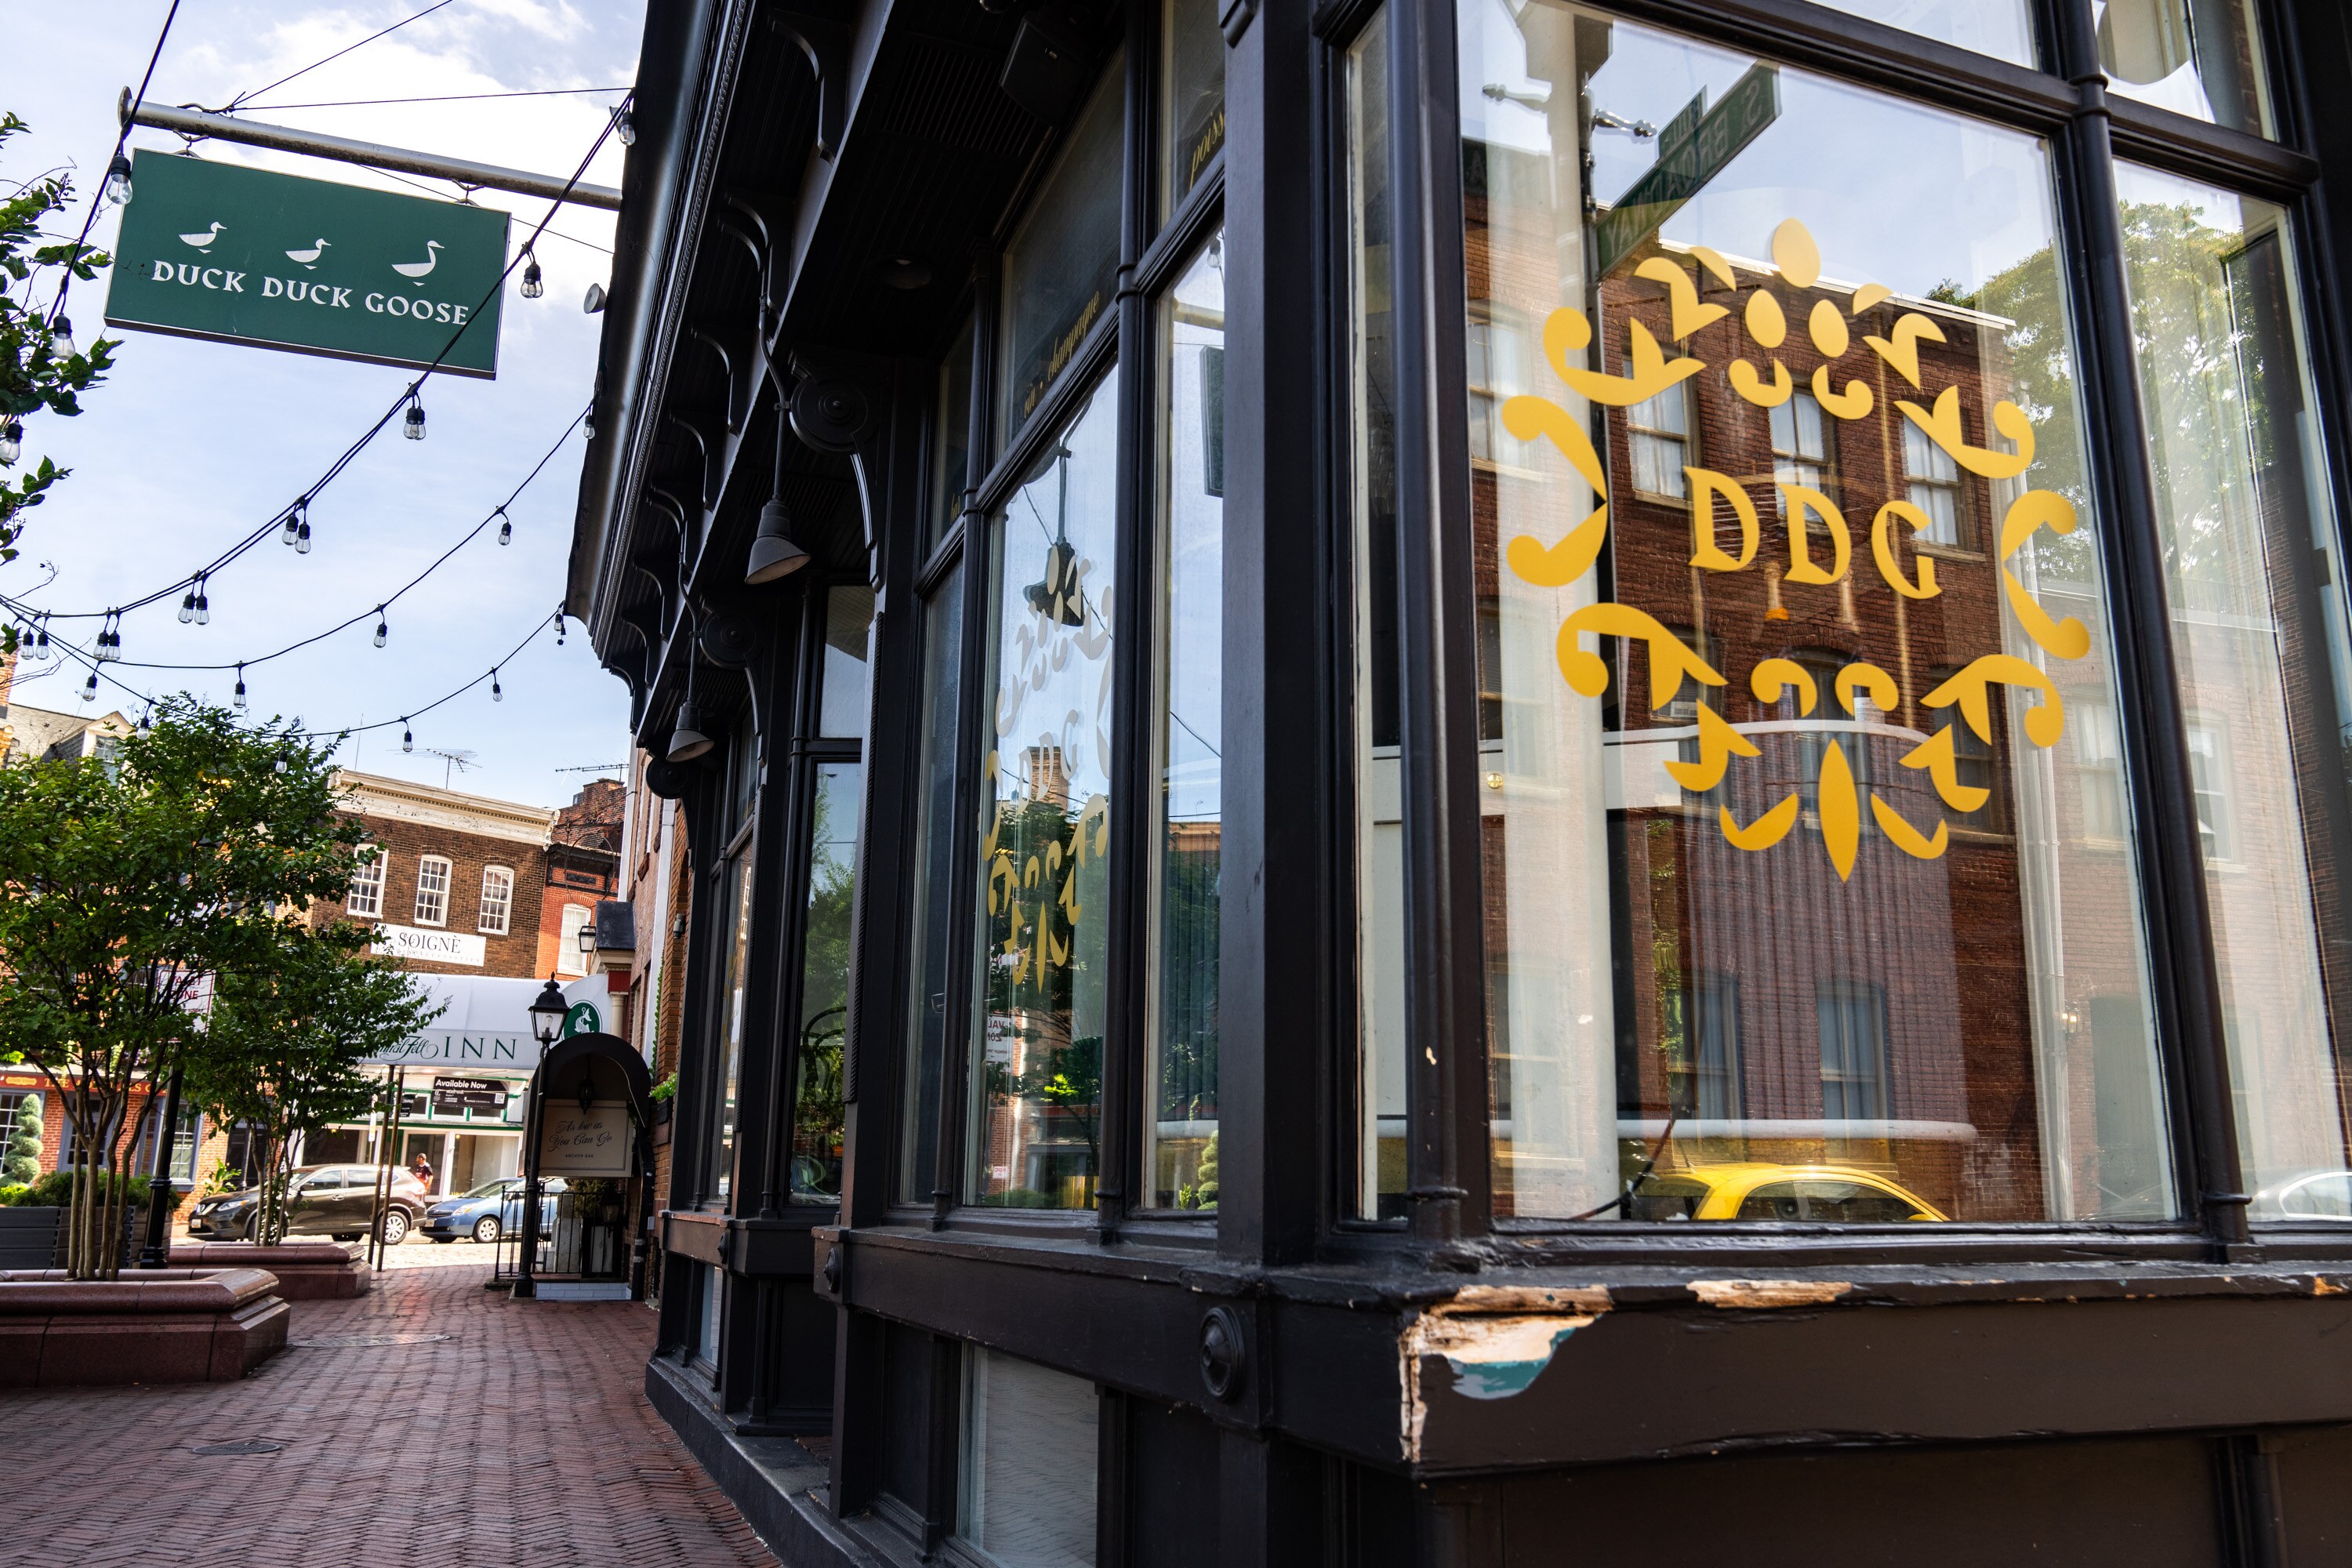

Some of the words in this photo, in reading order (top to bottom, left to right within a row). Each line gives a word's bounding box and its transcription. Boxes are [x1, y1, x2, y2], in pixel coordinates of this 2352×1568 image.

[1189, 111, 1225, 191] poiss
[152, 260, 247, 292] DUCK
[262, 276, 353, 308] DUCK
[365, 292, 469, 326] GOOSE
[1683, 465, 1943, 600] DDG
[1016, 710, 1078, 818] DDG
[444, 1036, 517, 1060] INN
[435, 1079, 469, 1088] Available
[547, 1134, 570, 1152] You
[574, 1132, 593, 1145] Can
[596, 1131, 612, 1147] Go
[556, 1120, 575, 1134] As
[578, 1120, 593, 1131] low
